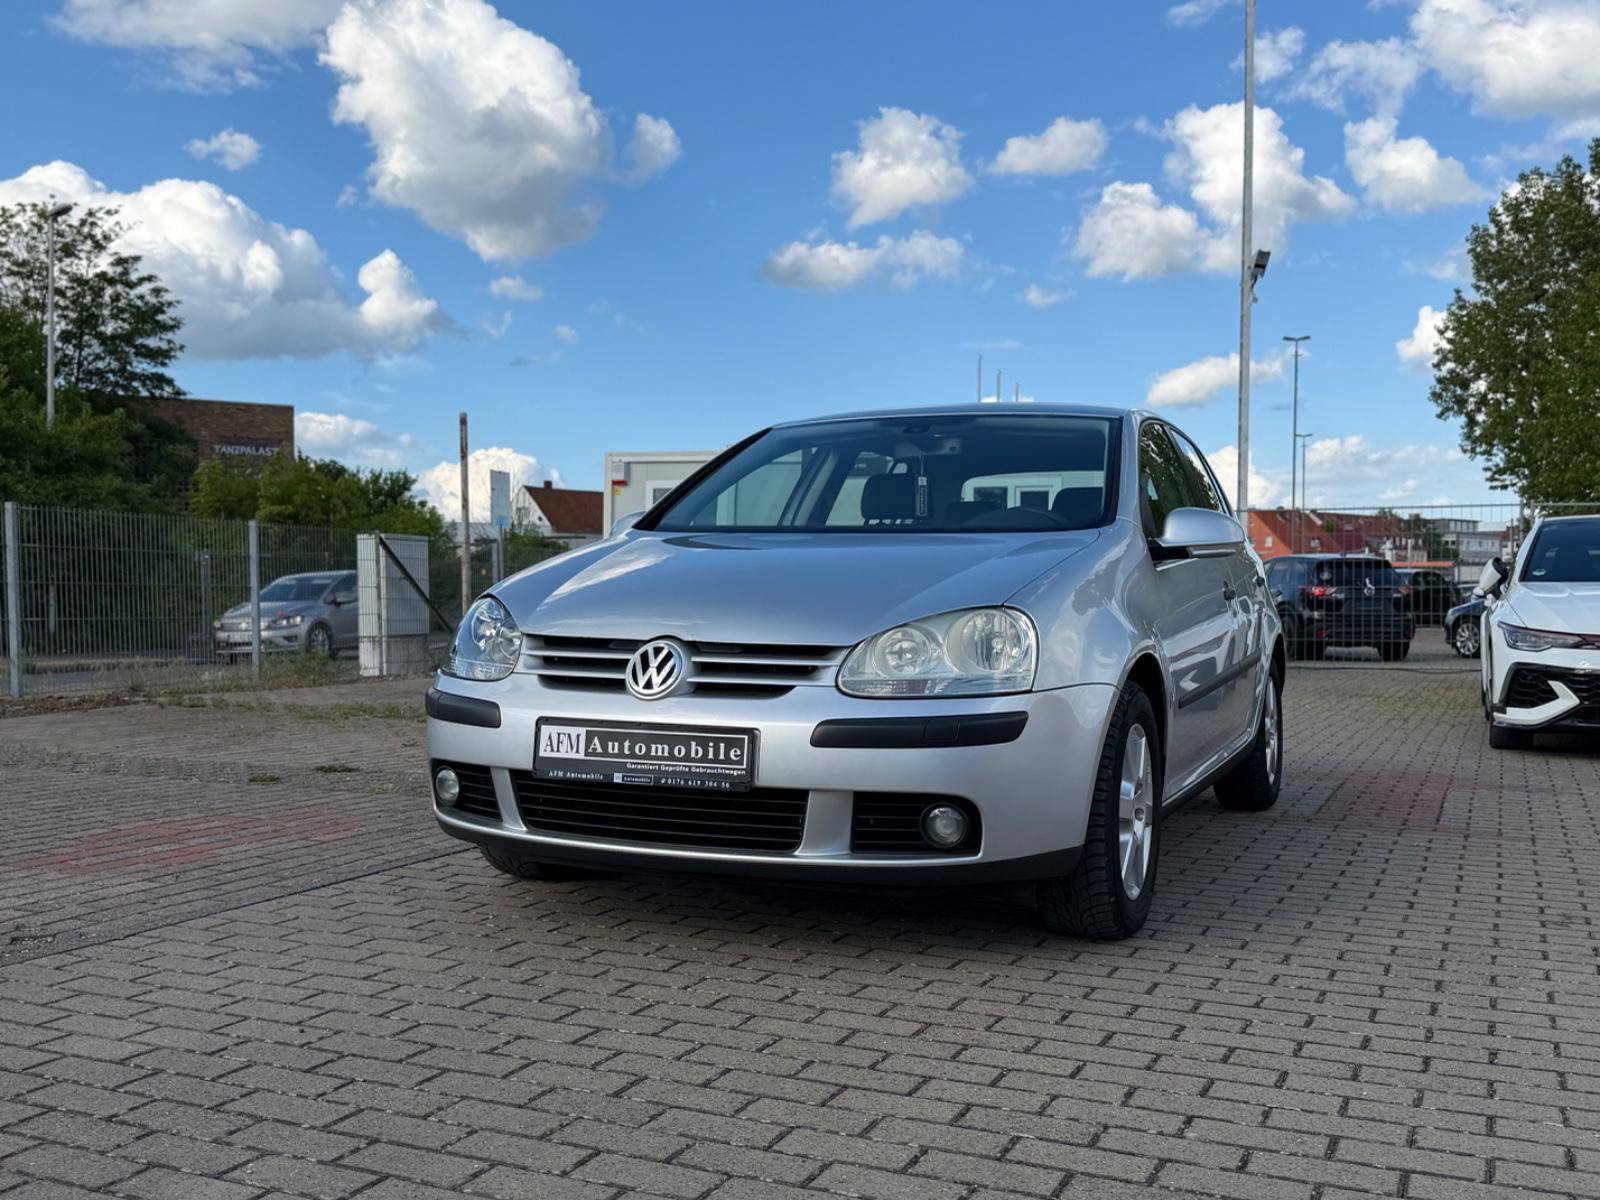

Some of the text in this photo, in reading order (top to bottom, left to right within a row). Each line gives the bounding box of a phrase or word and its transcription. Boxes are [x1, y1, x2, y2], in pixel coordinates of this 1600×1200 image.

[213, 444, 279, 457] TANZPALAST
[544, 732, 742, 760] AFM Automobile
[626, 762, 659, 771] Garantiert
[690, 766, 746, 776] Gebrauchtwagen
